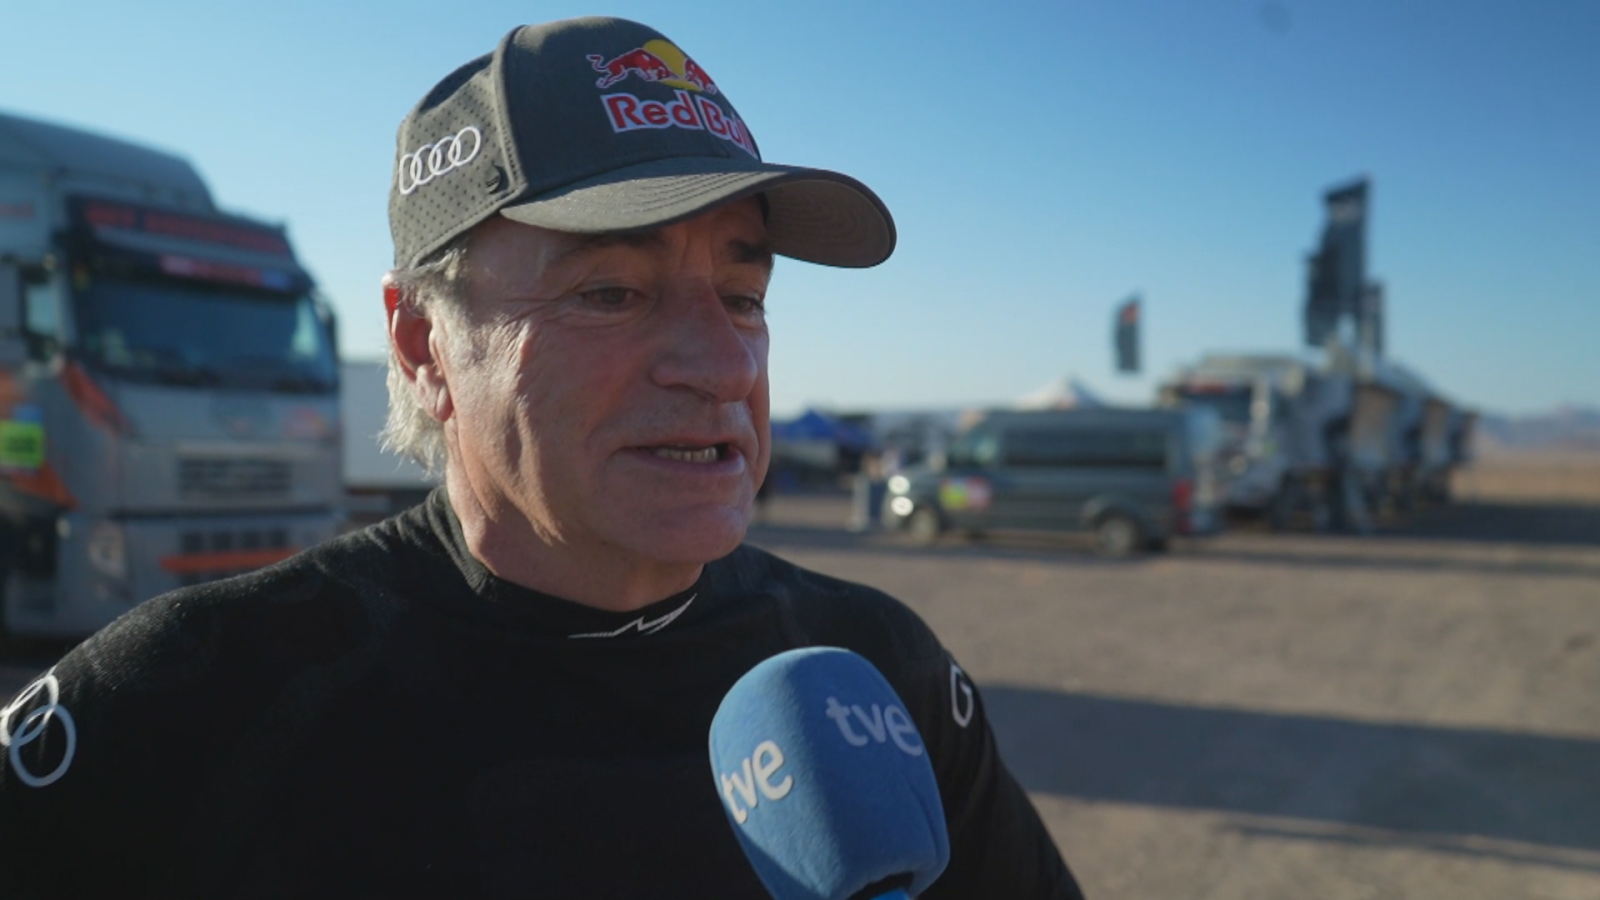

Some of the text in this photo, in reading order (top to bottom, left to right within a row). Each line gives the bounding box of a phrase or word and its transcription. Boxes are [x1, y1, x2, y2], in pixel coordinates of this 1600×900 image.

[602, 91, 703, 132] Red
[825, 696, 923, 756] tve
[720, 740, 793, 824] tve
